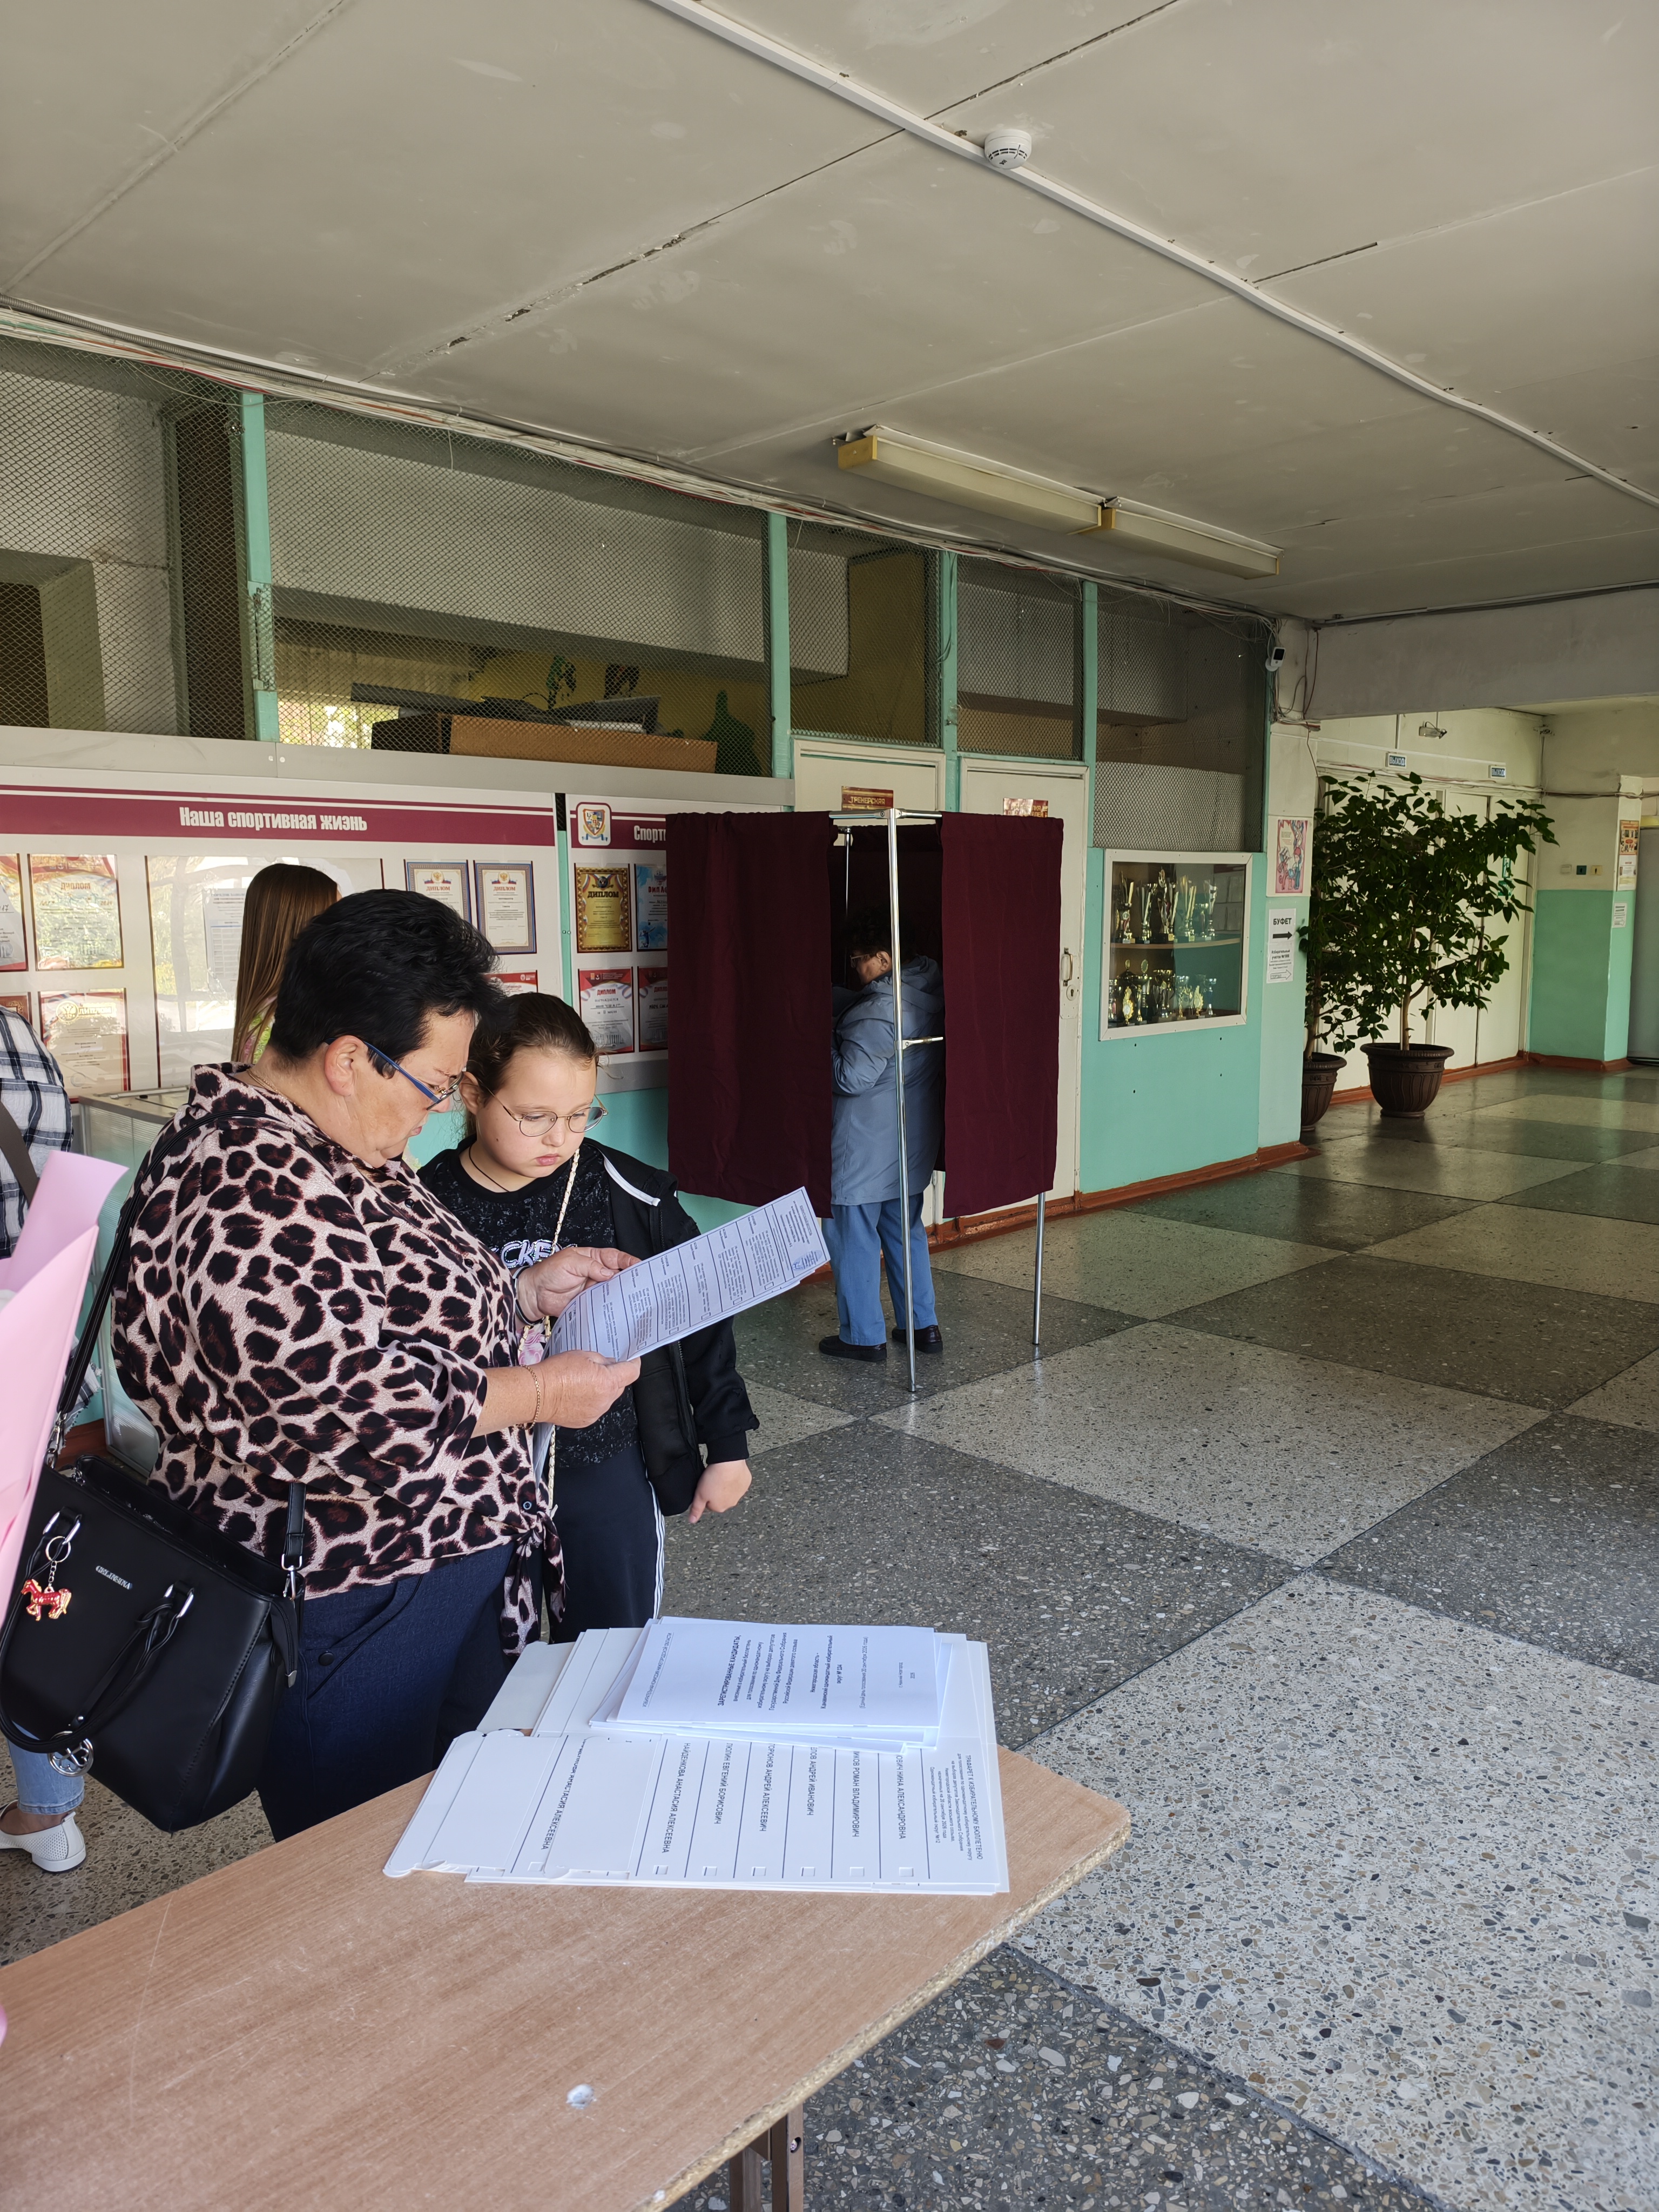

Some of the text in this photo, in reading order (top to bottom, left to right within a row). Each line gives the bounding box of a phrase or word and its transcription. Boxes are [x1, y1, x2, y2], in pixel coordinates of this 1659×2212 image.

[1390, 757, 1405, 766] ВЫХОД
[851, 797, 885, 805] ТРЕНЕРСКАЯ
[179, 807, 224, 827] Наша
[227, 812, 317, 831] спортивная
[718, 1635, 741, 1705] ЗАРЕГИСТРИРОВАННЫЕ КАНДИДАТЫ,
[738, 1660, 747, 1682] избирательный
[743, 1640, 751, 1658] бюллетень
[753, 1642, 764, 1670] одномандатному
[769, 1683, 779, 1710] Государственной
[776, 1650, 785, 1674] Федерального
[786, 1668, 794, 1685] Федерации
[757, 1683, 768, 1708] избирательному
[783, 1686, 791, 1703] Российской
[720, 1762, 730, 1786] ЕВГЕНИЙ
[764, 1769, 772, 1791] АНДРЕЙ
[808, 1761, 817, 1782] АНДРЕЙ
[965, 1755, 973, 1776] ТРАФАРЕТ
[557, 1775, 575, 1809] АНАСТАСИЯ
[662, 1743, 691, 1853] НАЙДЕНКОВА АНАСТАСИЯ АЛЕКСЕЕВНА
[714, 1788, 726, 1824] БОРИСОВИЧ
[807, 1783, 815, 1815] ИВАНОВИЧ
[968, 1781, 979, 1825] ИЗБИРАТЕЛЬНОМУ
[759, 1792, 770, 1831] АЛЕКСЕЕВИЧ
[851, 1788, 859, 1837] ВЛАДИМИРОВИЧ
[897, 1788, 906, 1839] АЛЕКСАНДРОВНА
[541, 1810, 563, 1850] АЛЕКСЕЕВНА
[974, 1826, 983, 1859] БЮЛЛЕТЕНЮ
